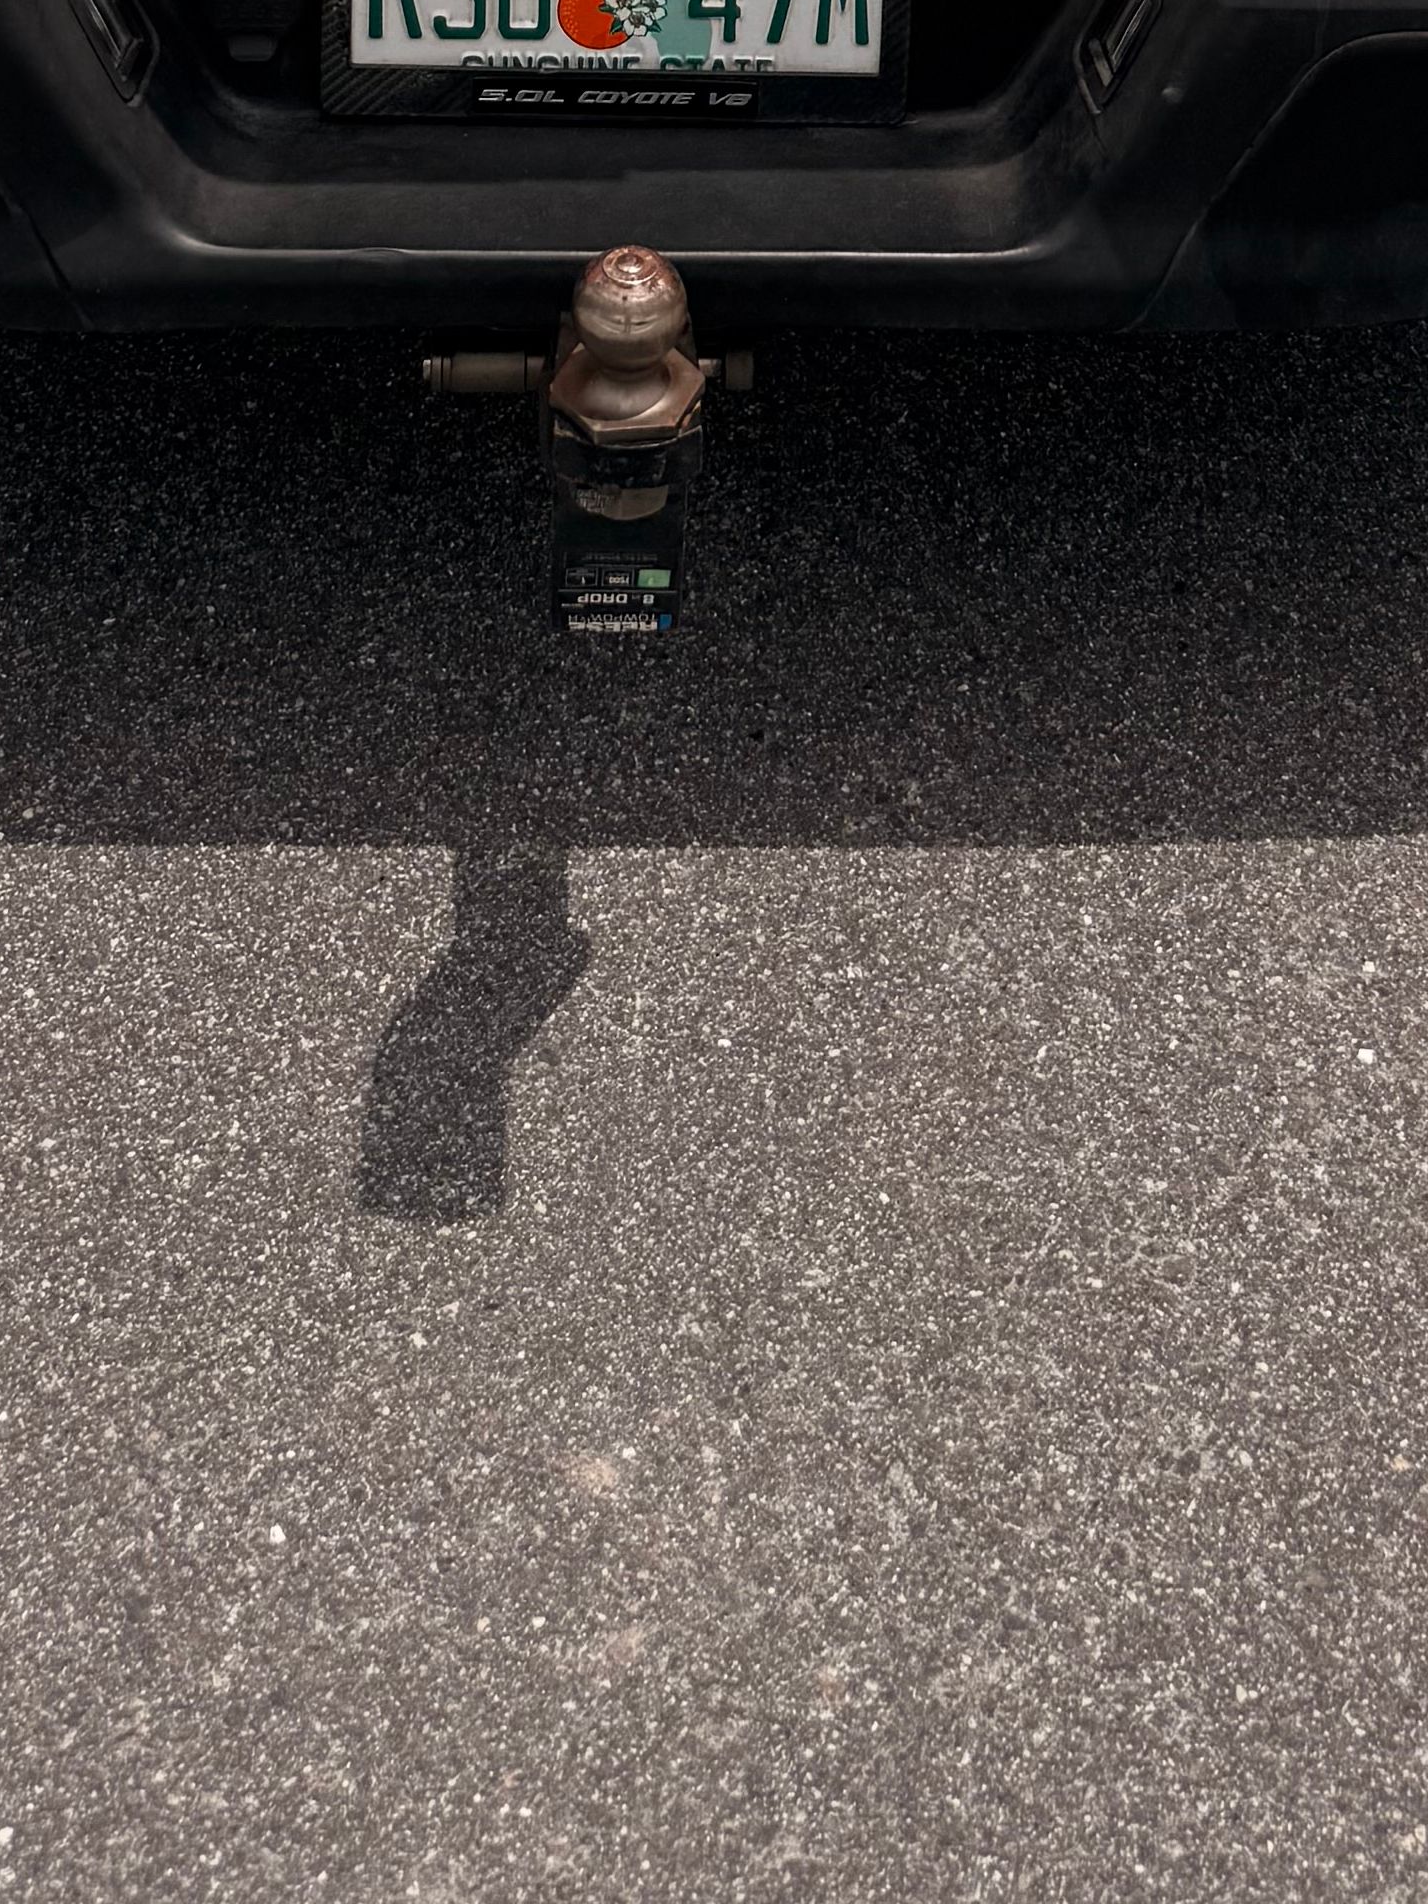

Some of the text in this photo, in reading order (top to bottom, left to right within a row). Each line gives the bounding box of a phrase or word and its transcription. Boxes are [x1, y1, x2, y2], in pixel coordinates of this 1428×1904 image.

[478, 88, 753, 106] 5.0L COYOTE V8
[577, 593, 628, 604] DROP
[642, 594, 655, 604] 8
